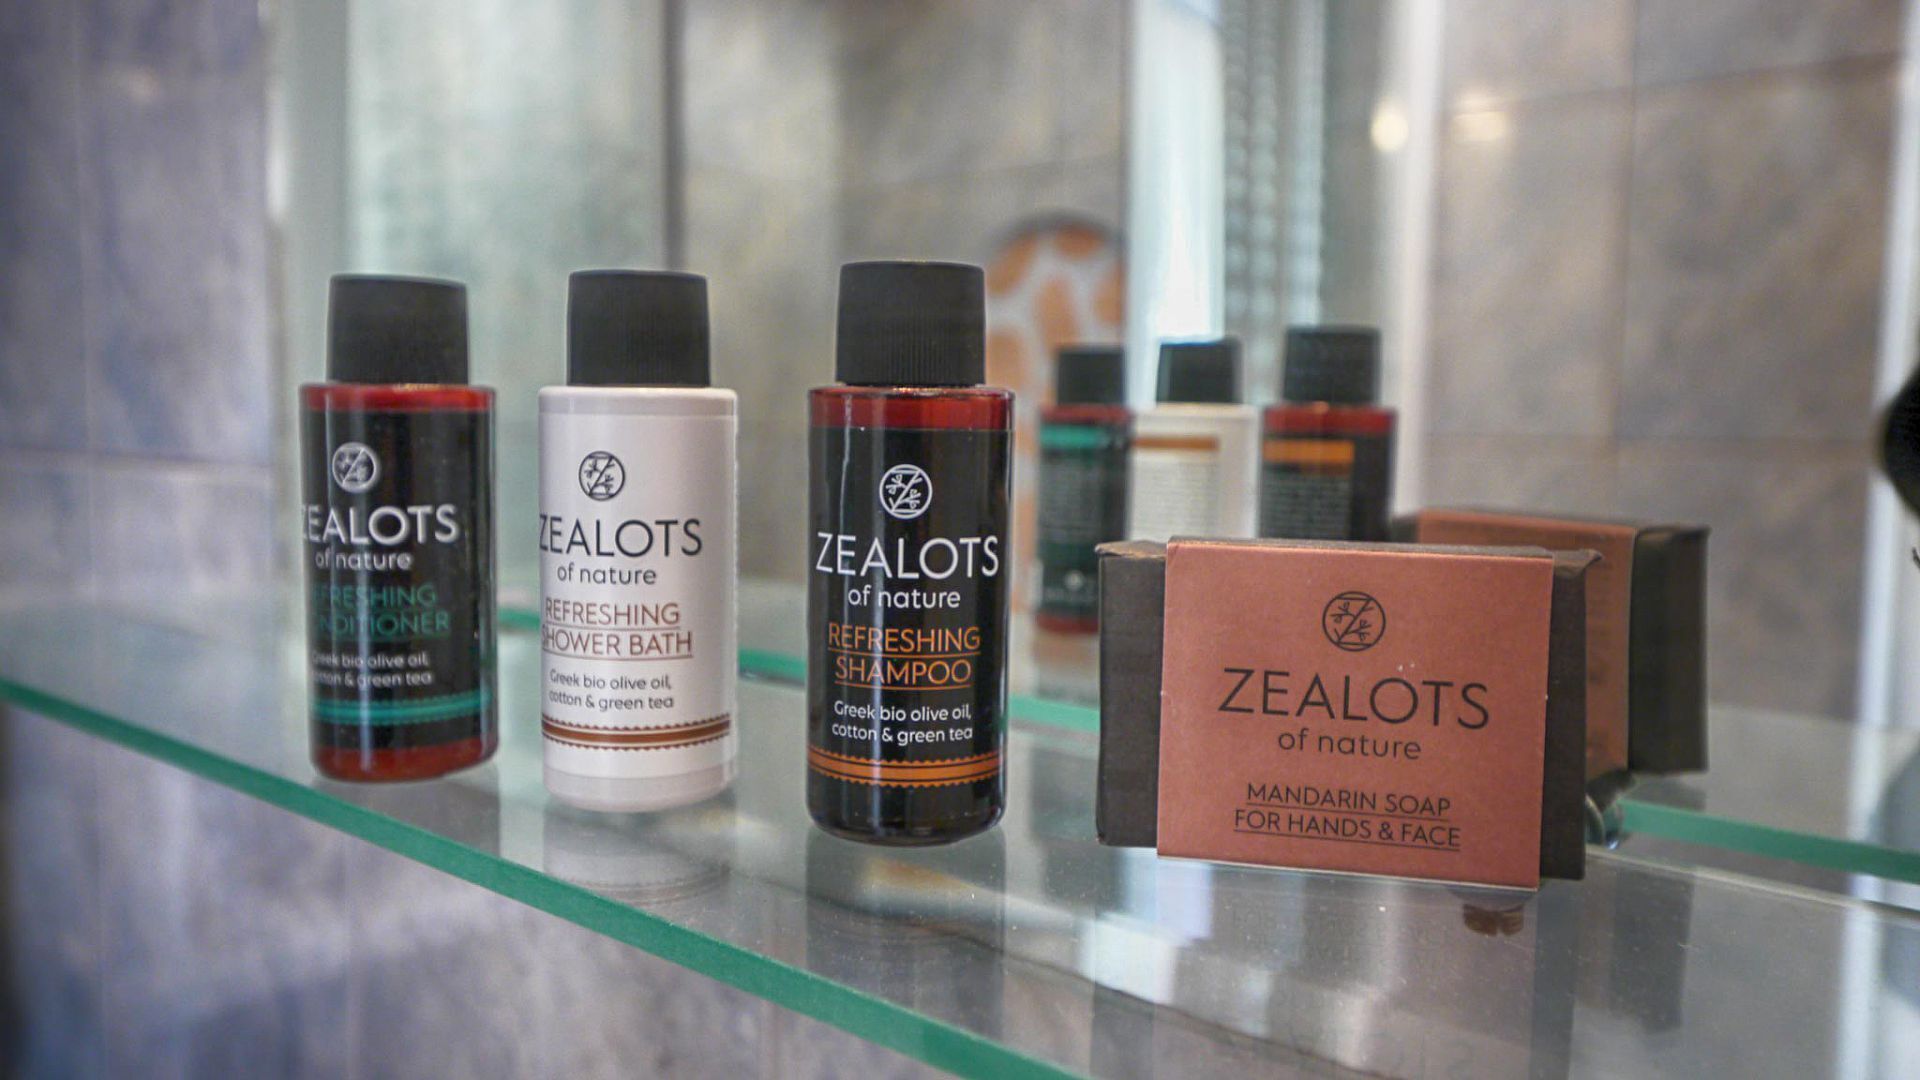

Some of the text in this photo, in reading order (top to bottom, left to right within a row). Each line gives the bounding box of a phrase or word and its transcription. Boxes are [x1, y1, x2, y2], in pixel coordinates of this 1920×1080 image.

[303, 504, 460, 545] EALOTS
[539, 513, 703, 558] ZEALOTS
[315, 547, 413, 571] of nature
[815, 532, 1000, 580] ZEALOTS
[557, 561, 657, 585] of nature
[848, 584, 961, 609] of nature
[545, 597, 681, 626] REFRESHING
[629, 631, 693, 656] BATH
[828, 622, 981, 653] REFRESHING
[341, 652, 363, 668] bio
[366, 652, 404, 669] olive
[835, 655, 972, 685] SHAMPOO
[344, 671, 354, 687] &
[357, 672, 401, 690] green
[405, 671, 432, 686] tea
[549, 668, 672, 690] Greek bio olive oil,
[548, 689, 674, 713] cotton & green tea
[834, 699, 972, 721] Greek bio olive oil,
[1217, 667, 1490, 731] ZEALOTS
[832, 723, 973, 746] cotton & green tea
[1278, 728, 1422, 760] of nature
[1247, 782, 1451, 817] MANDARIN SOAP
[1234, 809, 1461, 848] FOR HANDS & FACE
